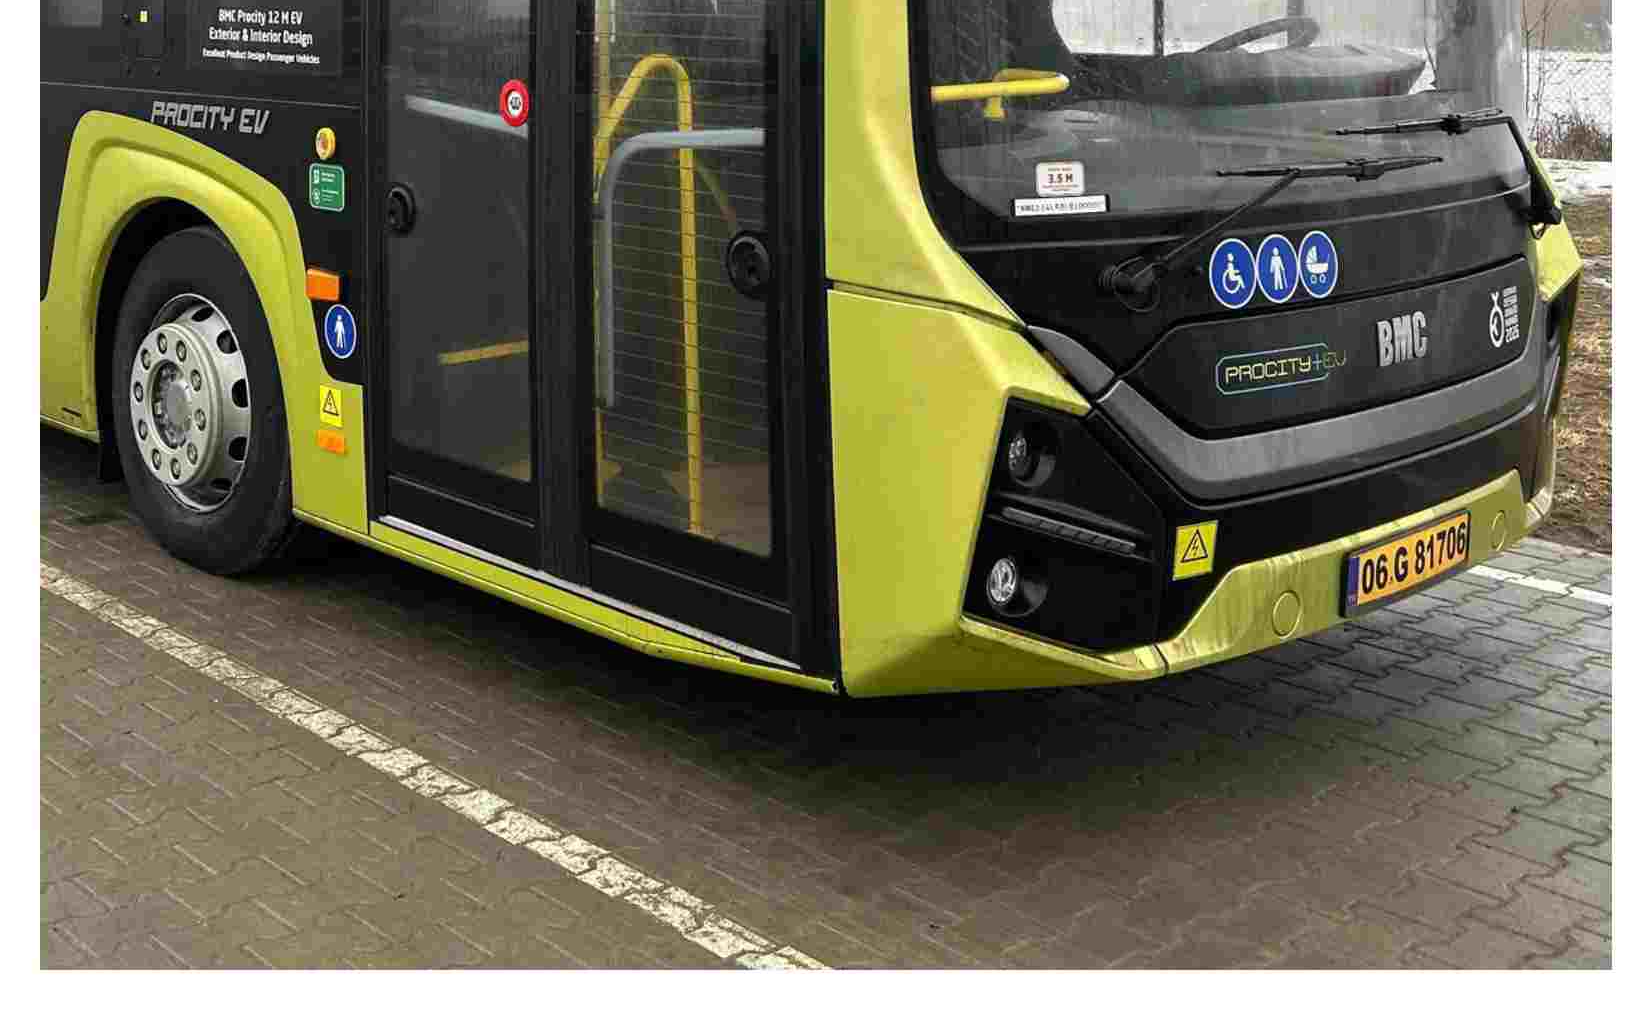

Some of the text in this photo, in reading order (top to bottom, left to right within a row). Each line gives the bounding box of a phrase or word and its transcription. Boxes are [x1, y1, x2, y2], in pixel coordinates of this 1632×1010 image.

[219, 9, 236, 22] BMC
[237, 9, 266, 27] Procity
[268, 10, 280, 24] 12
[291, 11, 303, 25] EV
[209, 27, 313, 48] Exterior & Interior Design
[151, 100, 270, 134] PROCITY EV
[1376, 311, 1428, 367] BMC
[1415, 522, 1466, 575] 81706
